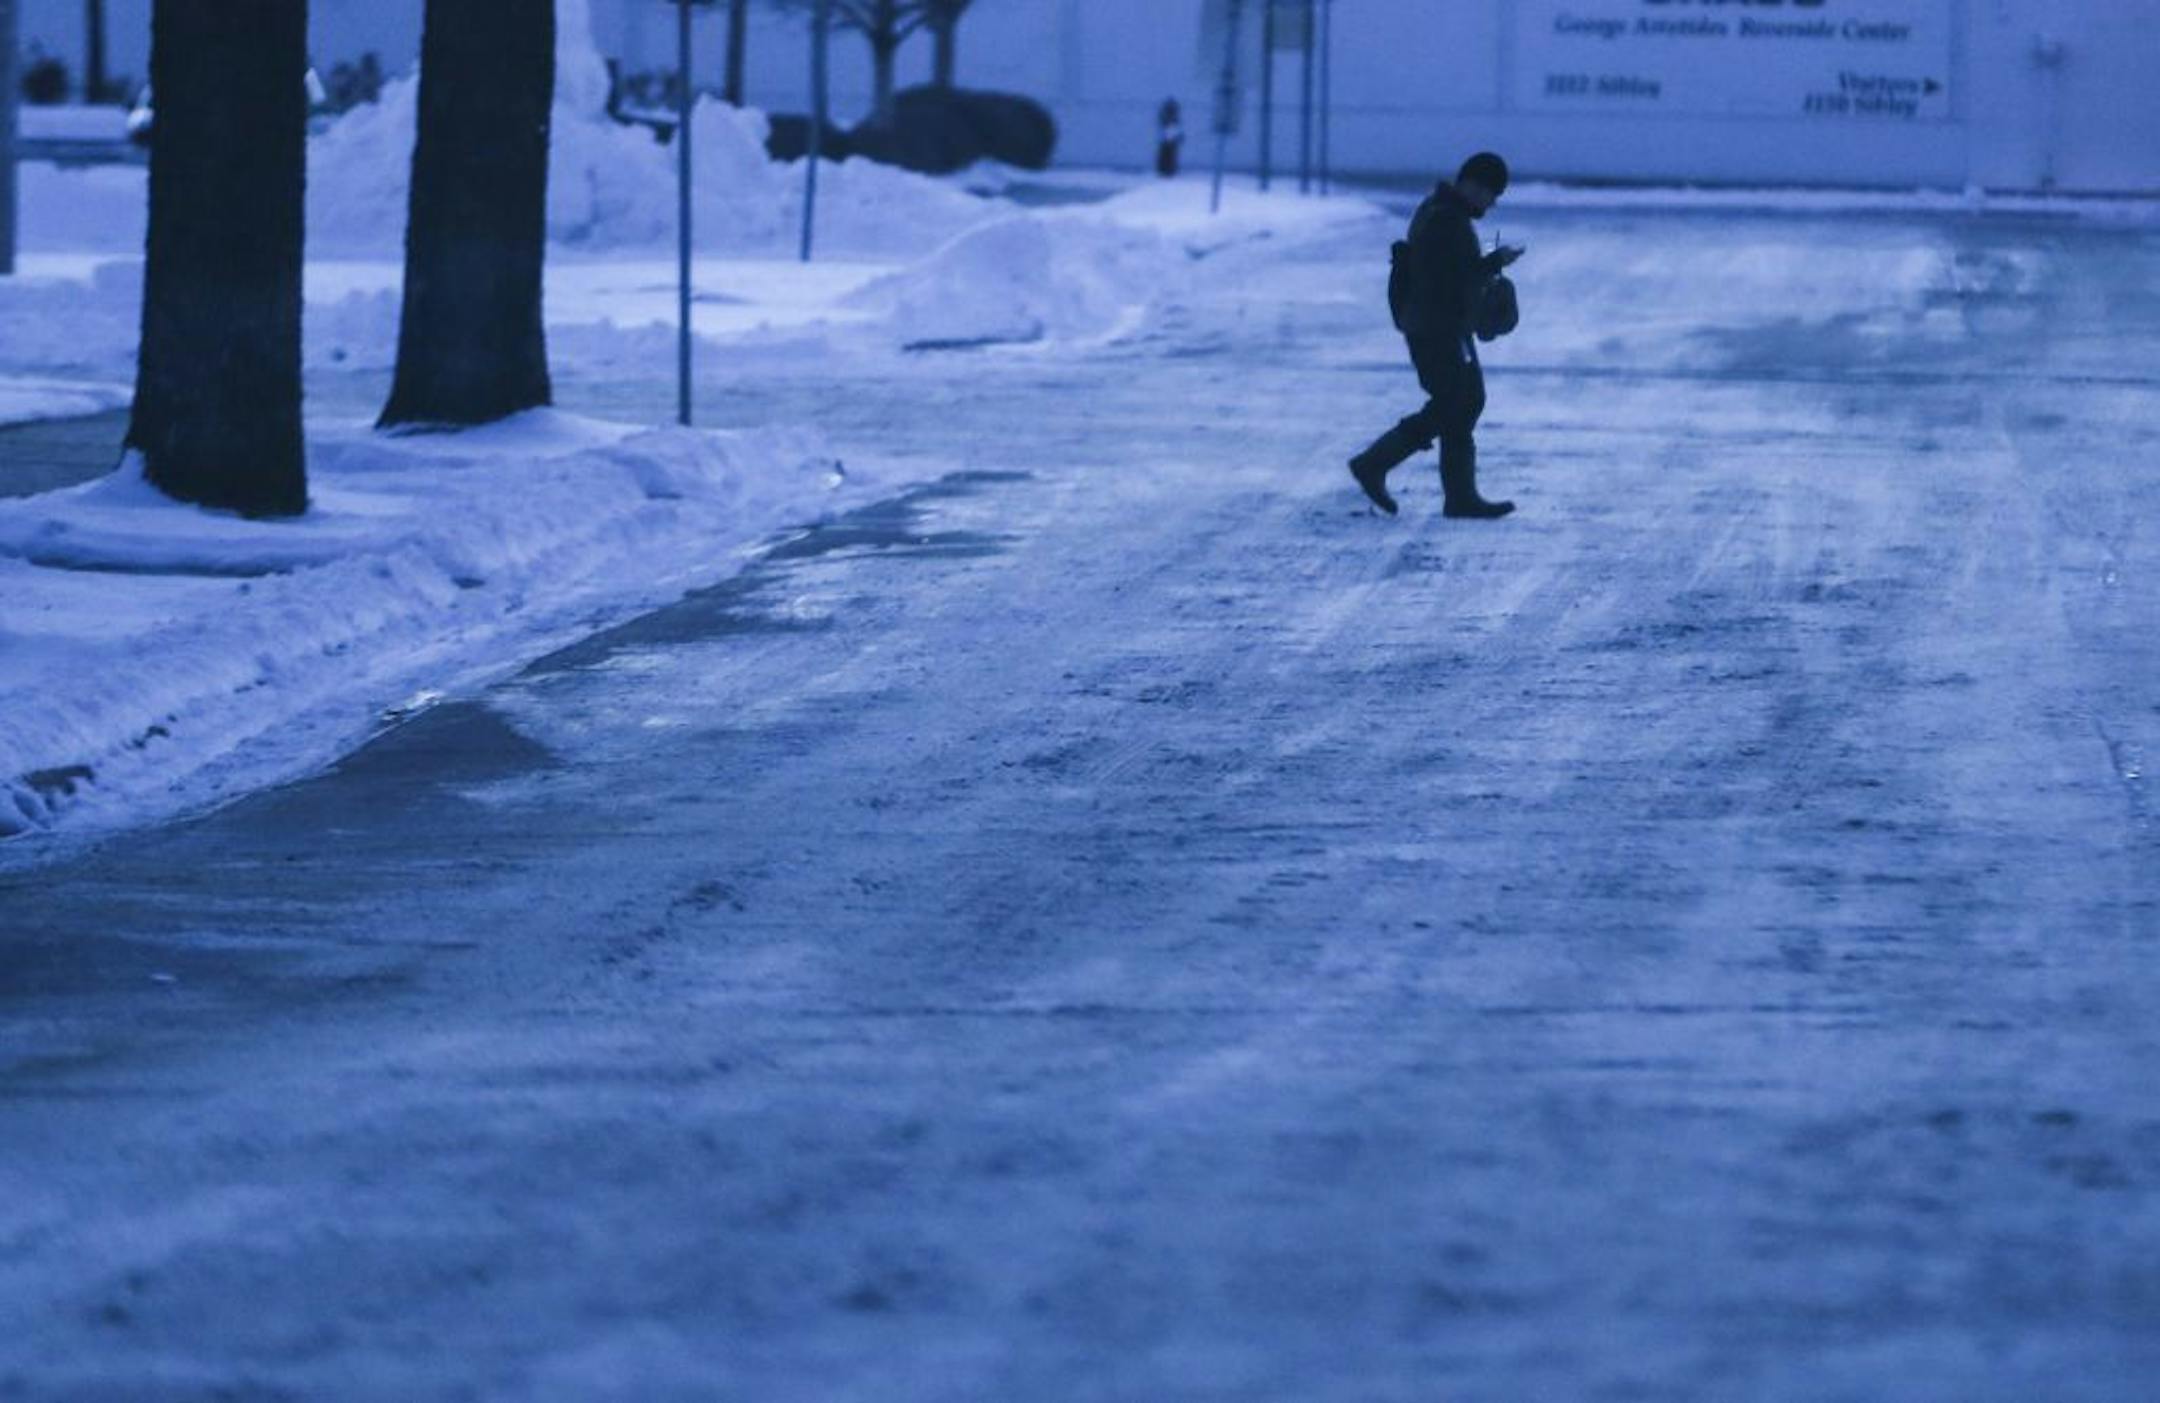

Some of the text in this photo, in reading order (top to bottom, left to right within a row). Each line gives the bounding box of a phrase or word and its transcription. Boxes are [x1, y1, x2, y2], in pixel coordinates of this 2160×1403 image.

[1554, 15, 1627, 38] George
[1739, 16, 1836, 38] Riverside
[1842, 17, 1911, 40] Center
